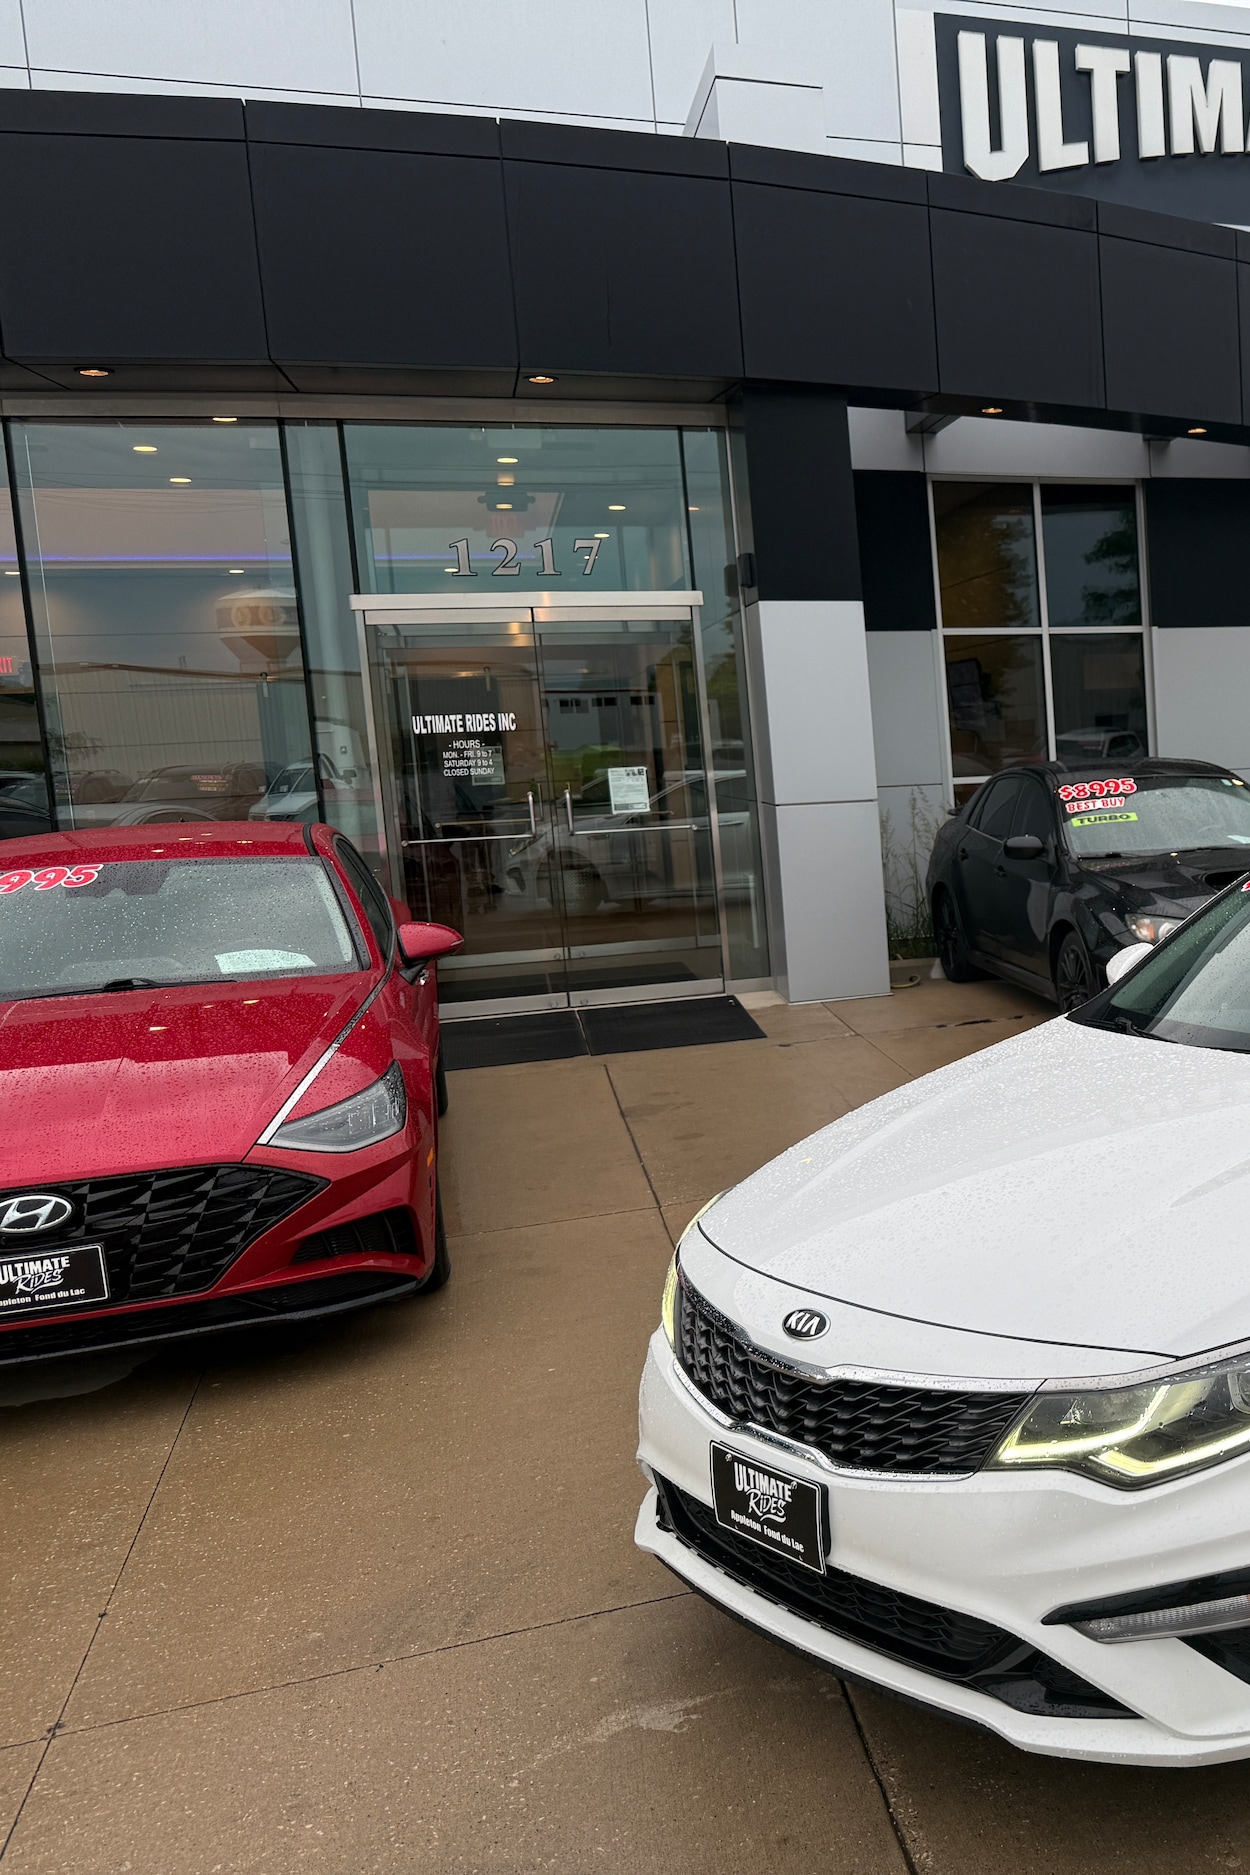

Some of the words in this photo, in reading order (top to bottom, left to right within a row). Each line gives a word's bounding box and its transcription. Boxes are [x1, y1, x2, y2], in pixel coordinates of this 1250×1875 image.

[449, 538, 602, 577] 1217
[412, 714, 464, 735] ULTIMATE
[465, 713, 497, 732] RIDES
[498, 712, 517, 731] INC
[453, 739, 481, 749] HOURS
[442, 751, 460, 759] MON.
[476, 750, 481, 758] 9
[488, 749, 493, 757] 7
[443, 759, 477, 768] SATURDAY
[488, 758, 493, 766] 4
[443, 768, 469, 777] CLOSED
[470, 767, 495, 776] SUNDAY
[1058, 778, 1137, 800] $8995
[1066, 800, 1097, 813] BEST
[1100, 797, 1126, 809] BUY
[1077, 814, 1131, 824] TURBO
[0, 1256, 70, 1285] ULTIMATE
[35, 1291, 57, 1301] Fond
[57, 1290, 69, 1299] du
[70, 1288, 86, 1297] Lac
[784, 1309, 822, 1337] KIA
[734, 1461, 792, 1502] ULTIMATE
[731, 1509, 762, 1532] Appleton
[763, 1524, 781, 1542] Fond
[781, 1534, 791, 1547] du
[791, 1537, 805, 1553] Lac
